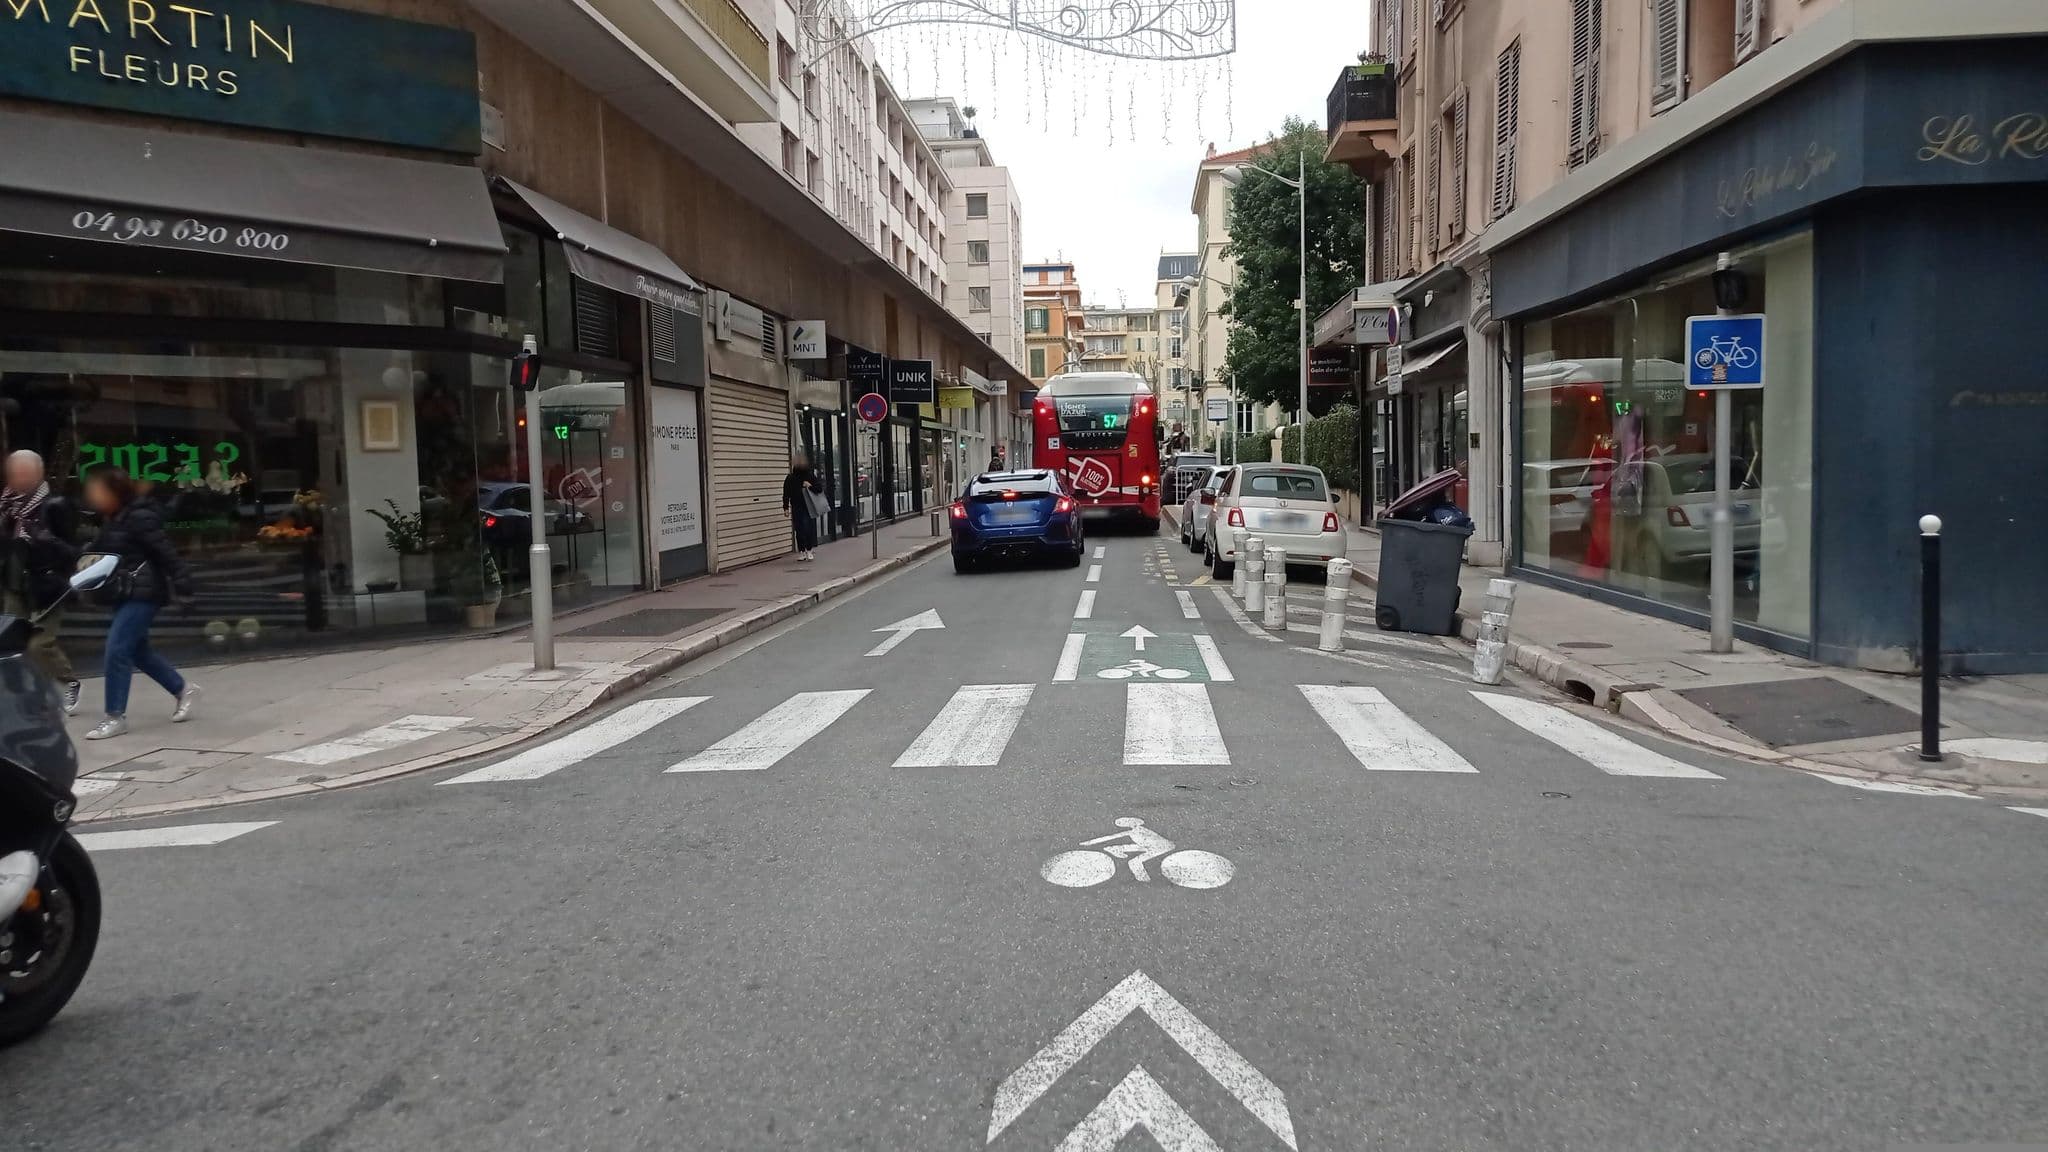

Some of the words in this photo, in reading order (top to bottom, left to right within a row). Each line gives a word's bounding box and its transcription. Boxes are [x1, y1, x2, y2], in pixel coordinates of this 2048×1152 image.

[69, 46, 238, 95] FLEURS
[1917, 114, 1992, 165] La
[72, 211, 116, 232] 04
[113, 217, 164, 241] 93
[171, 218, 228, 243] 620
[235, 227, 289, 250] 800
[793, 343, 817, 353] MNT
[896, 372, 927, 383] UNIK
[1103, 414, 1118, 428] 57
[1085, 468, 1105, 486] 100%
